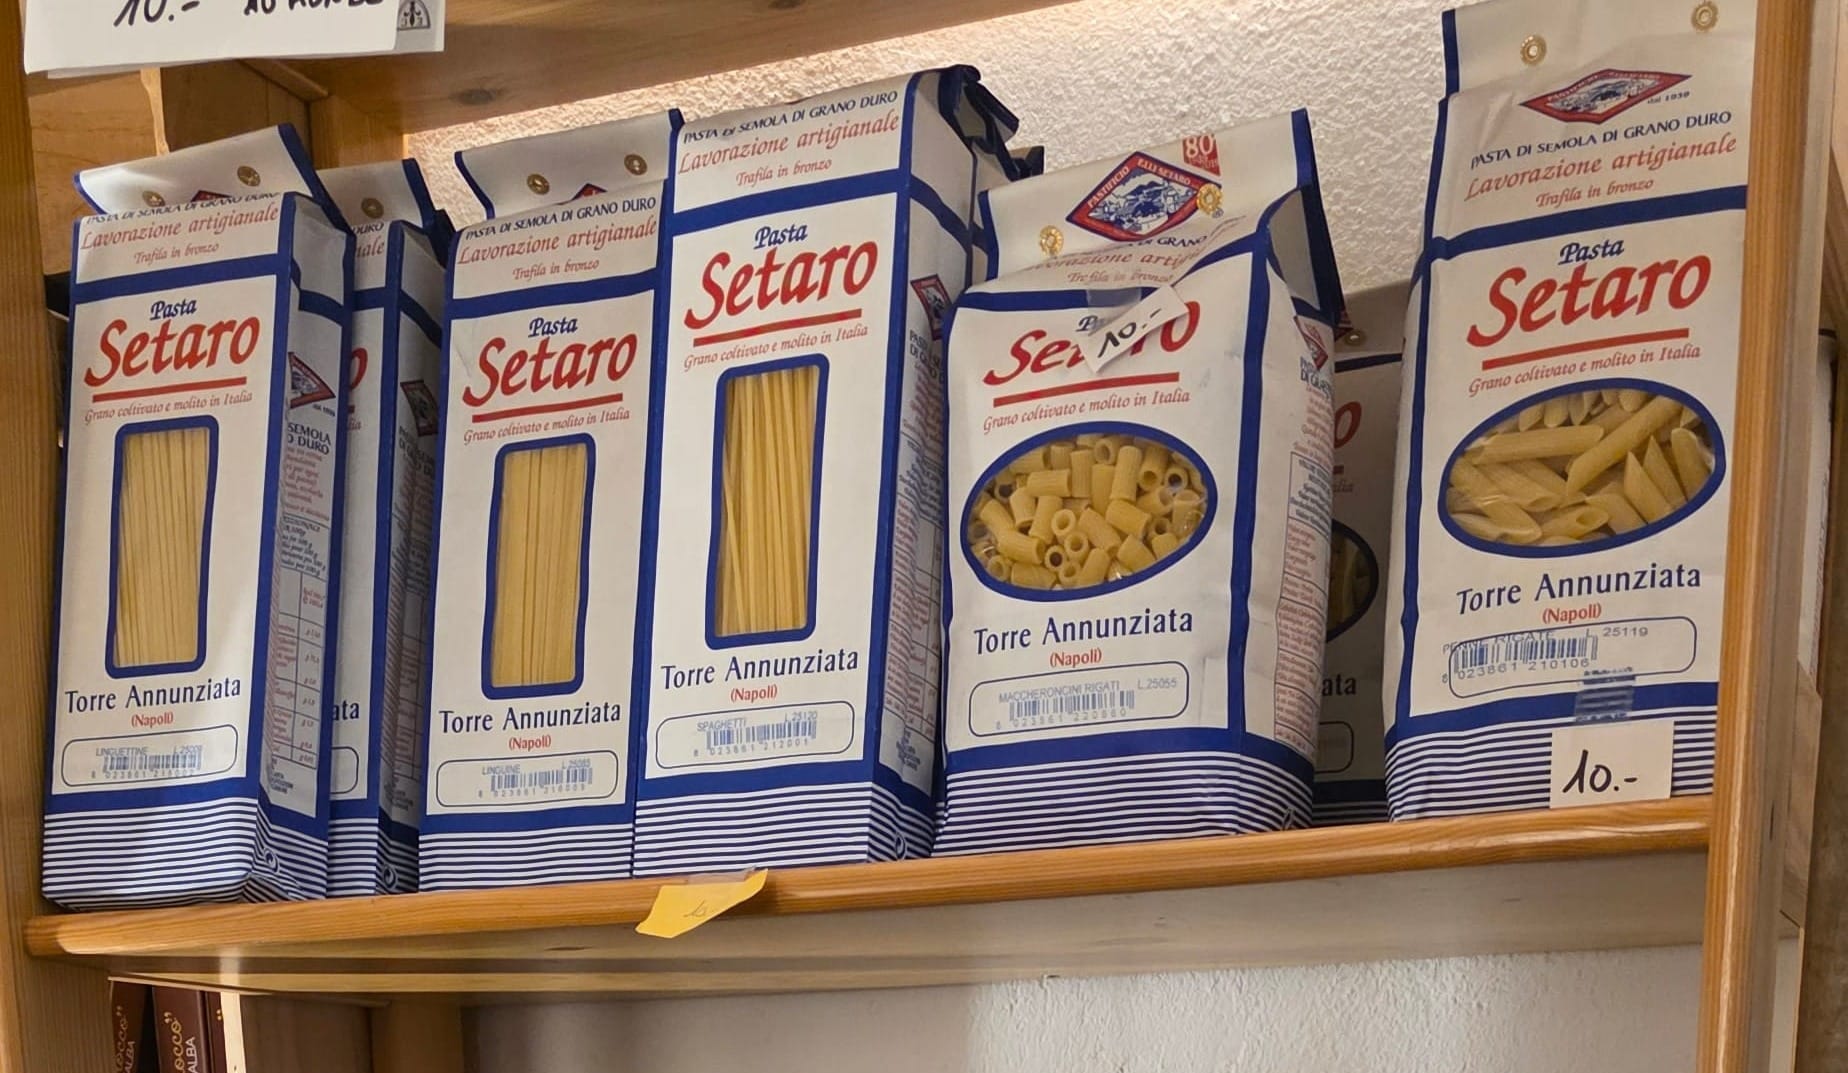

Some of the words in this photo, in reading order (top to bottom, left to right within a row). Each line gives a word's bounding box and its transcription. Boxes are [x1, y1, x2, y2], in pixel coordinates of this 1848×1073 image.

[684, 127, 719, 143] PASTA
[737, 113, 788, 134] SEMOLA
[792, 109, 806, 122] DI
[809, 99, 856, 120] GRANO
[860, 90, 898, 109] DURO
[678, 137, 789, 174] Lavorazione
[796, 107, 900, 149] artigianale
[1471, 147, 1511, 169] PASTA
[1516, 143, 1532, 158] DI
[1537, 134, 1598, 155] SEMOLA
[1602, 129, 1618, 143] DI
[1624, 118, 1680, 141] GRANO
[1685, 110, 1732, 128] DURO
[736, 167, 774, 187] Trafila
[777, 164, 789, 176] in
[793, 157, 832, 174] bronzo
[1464, 155, 1602, 202] Lavorazione
[1611, 131, 1737, 172] artigianale
[1087, 166, 1131, 209] PASTIFICIO
[1535, 185, 1582, 208] Trafila
[1587, 182, 1601, 198] in
[1607, 178, 1654, 197] bronzo
[80, 221, 182, 250] Lavorazione
[188, 202, 279, 235] artigianale
[465, 226, 496, 241] PASTA
[500, 223, 511, 234] DI
[514, 213, 558, 230] SEMOLA
[561, 209, 573, 222] DI
[576, 202, 618, 219] GRANO
[622, 197, 656, 213] DURO
[754, 223, 808, 250] Pasta
[133, 248, 168, 266] Trafila
[171, 249, 181, 259] in
[184, 242, 219, 257] bronzo
[458, 234, 560, 265] Lavorazione
[567, 213, 657, 251] artigianale
[1558, 238, 1625, 265] Pasta
[512, 262, 546, 282] Trafila
[550, 261, 560, 273] in
[564, 258, 600, 273] bronzo
[684, 241, 878, 330] Setaro
[150, 298, 197, 320] Pasta
[1466, 254, 1712, 347] Setaro
[528, 317, 578, 338] Pasta
[1097, 307, 1163, 358] 10.-
[83, 315, 261, 388] Setaro
[684, 350, 718, 372] Grano
[720, 339, 770, 362] coltivato
[771, 343, 779, 352] e
[780, 334, 818, 353] molito
[820, 332, 833, 344] in
[836, 323, 868, 340] Italia
[462, 333, 638, 407] Setaro
[1469, 373, 1512, 396] Grano
[1514, 360, 1577, 387] coltivato
[1580, 361, 1587, 372] e
[1591, 352, 1636, 369] molito
[1640, 349, 1655, 363] in
[1660, 343, 1701, 360] Italia
[84, 408, 116, 426] Grano
[118, 400, 164, 420] coltivato
[165, 402, 171, 411] e
[174, 394, 208, 411] molito
[210, 396, 221, 406] in
[224, 389, 253, 406] Italia
[464, 429, 496, 445] Grano
[499, 418, 542, 438] coltivato
[544, 422, 551, 430] e
[553, 413, 585, 431] molito
[587, 413, 597, 424] in
[600, 408, 630, 422] Italia
[983, 413, 1018, 435] Grano
[1021, 402, 1076, 421] coltivato
[1079, 403, 1085, 413] e
[1089, 394, 1129, 413] molito
[1133, 393, 1147, 407] in
[1151, 387, 1190, 405] Italia
[1456, 585, 1521, 615] Torre
[1535, 562, 1701, 600] Annunziata
[974, 627, 1032, 655] Torre
[1042, 608, 1193, 647] Annunziata
[1543, 603, 1602, 625] (Napoli)
[1602, 626, 1649, 637] 25119
[661, 665, 715, 689] Torre
[725, 648, 858, 682] Annunziata
[1050, 648, 1103, 669] (Napoli)
[65, 688, 116, 714] Torre
[125, 676, 241, 708] Annunziata
[730, 683, 778, 703] (Napoli)
[999, 684, 1082, 703] MACCHERONCINI
[1085, 680, 1120, 693] RIGATI
[131, 711, 174, 729] (Napoli)
[440, 709, 493, 733] Torre
[502, 701, 622, 731] Annunziata
[697, 717, 748, 732] SPAGHETTI
[508, 734, 552, 751] (Napoli)
[1563, 749, 1638, 795] 10.-
